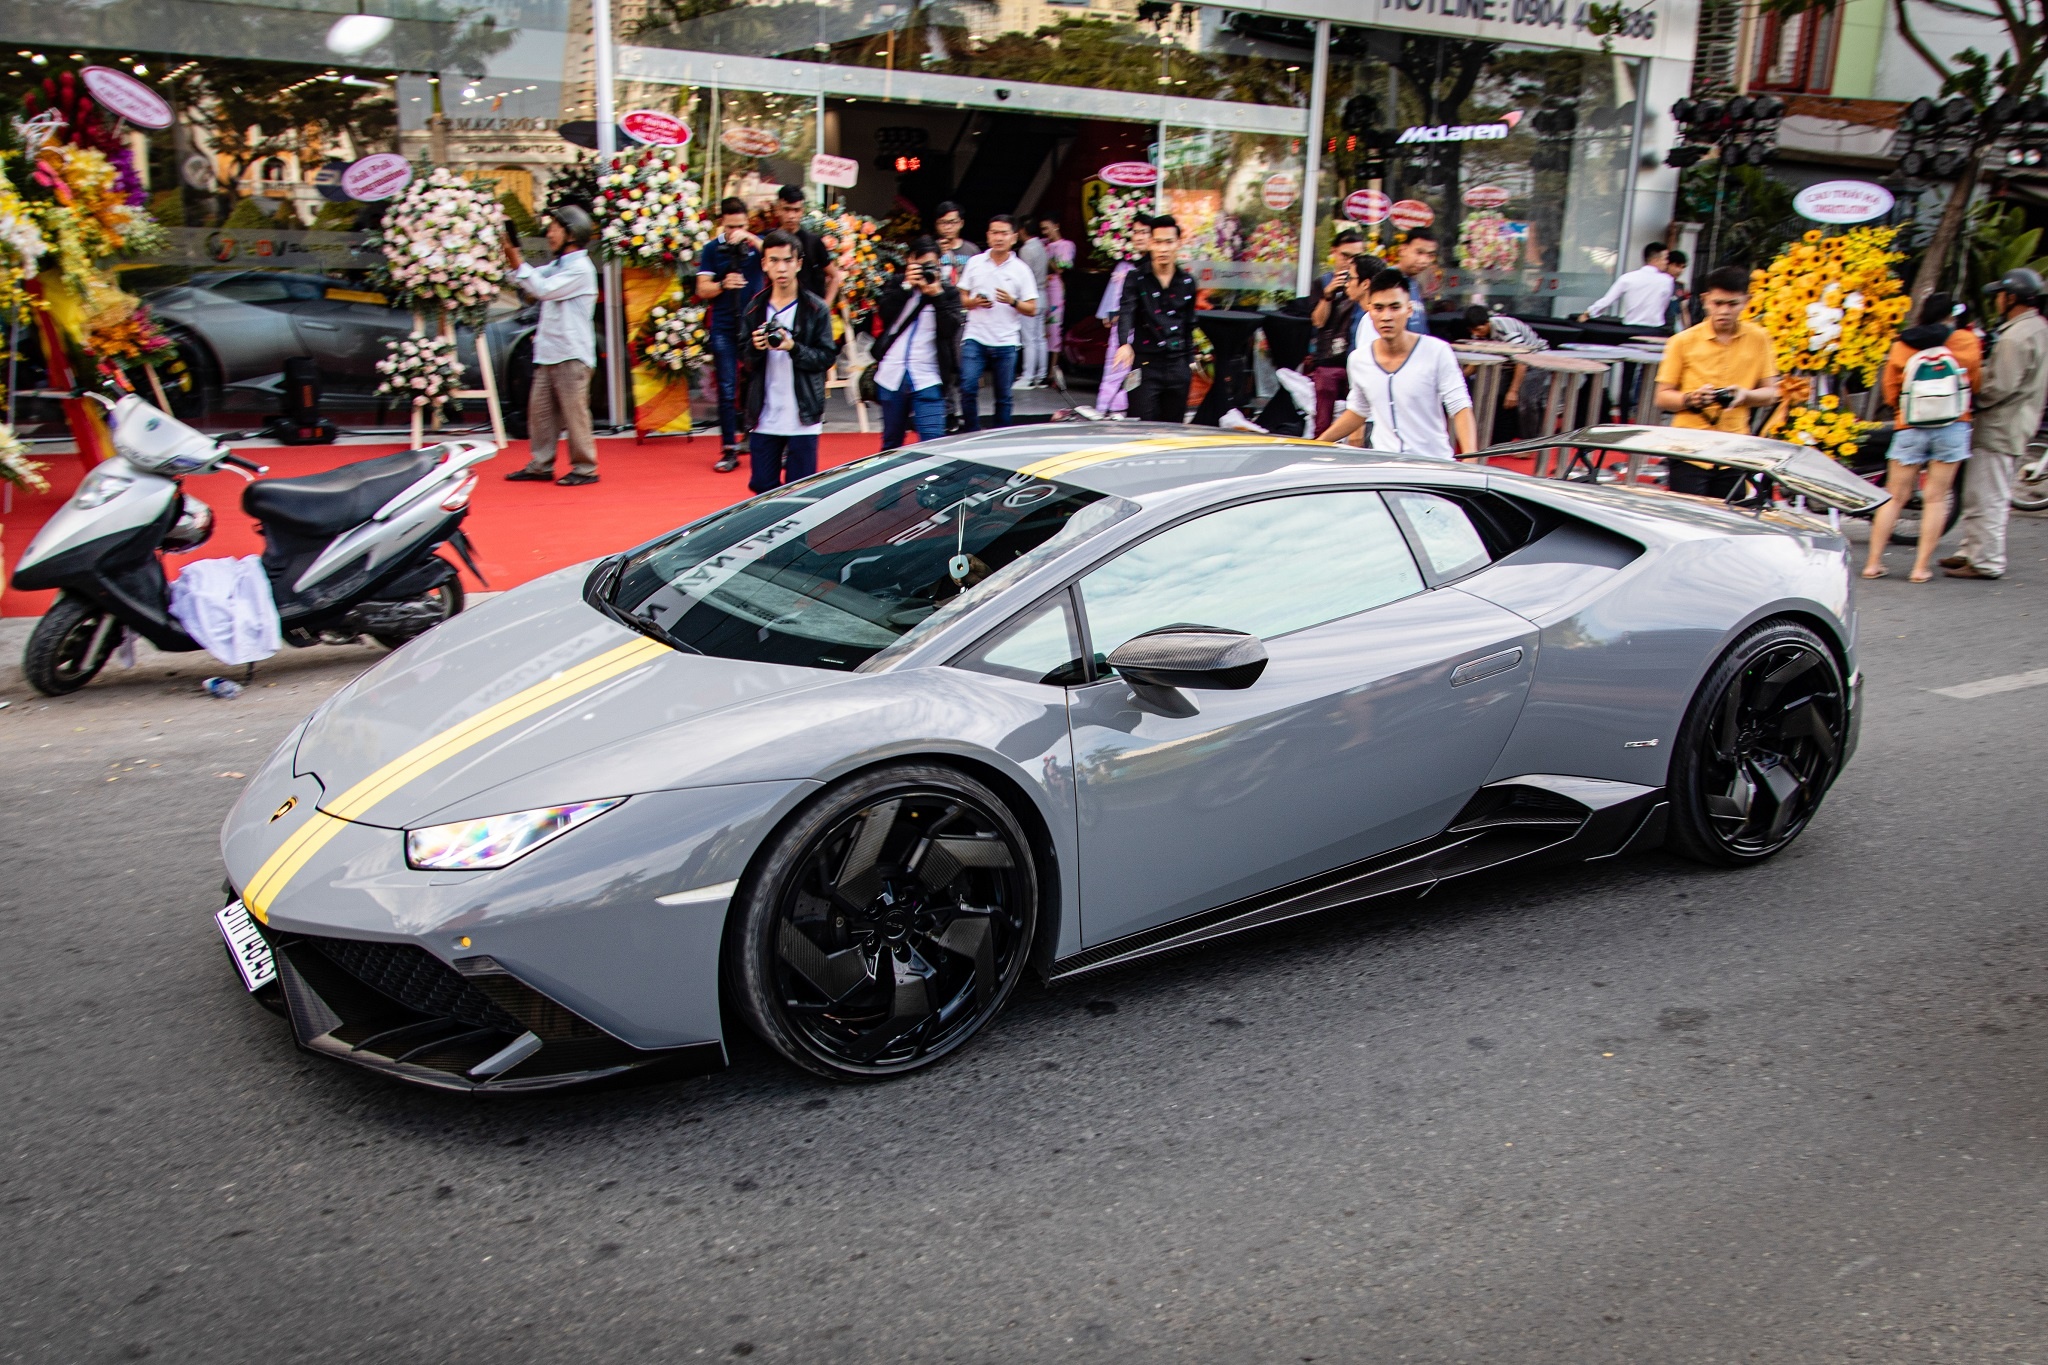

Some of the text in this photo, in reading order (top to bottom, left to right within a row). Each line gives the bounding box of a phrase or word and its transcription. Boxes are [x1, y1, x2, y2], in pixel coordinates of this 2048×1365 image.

[1383, 0, 1507, 21] LINE:
[1511, 0, 1566, 29] 0904
[1395, 124, 1508, 143] McLaren
